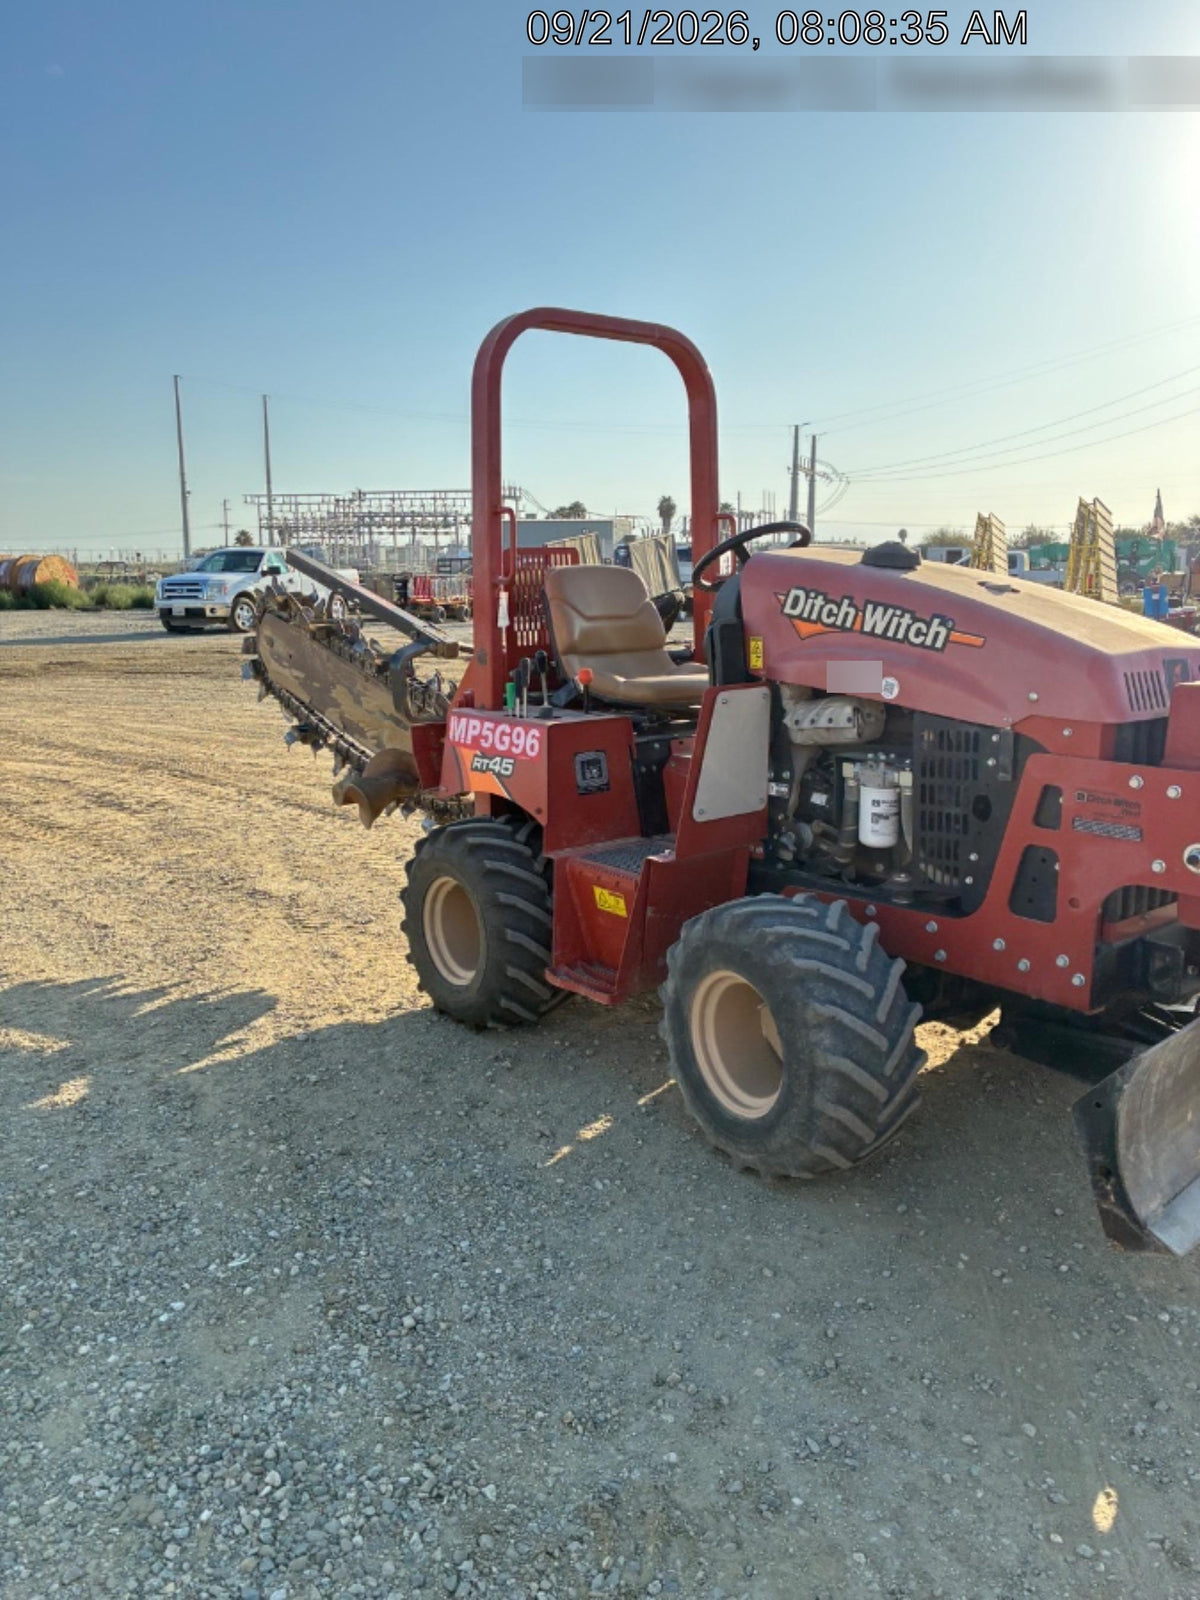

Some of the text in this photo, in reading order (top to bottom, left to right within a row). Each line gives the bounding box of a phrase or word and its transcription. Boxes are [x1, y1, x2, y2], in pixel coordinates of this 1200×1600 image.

[784, 588, 949, 648] Ditch Witch
[449, 715, 540, 757] MP5G96
[472, 756, 514, 776] RT45
